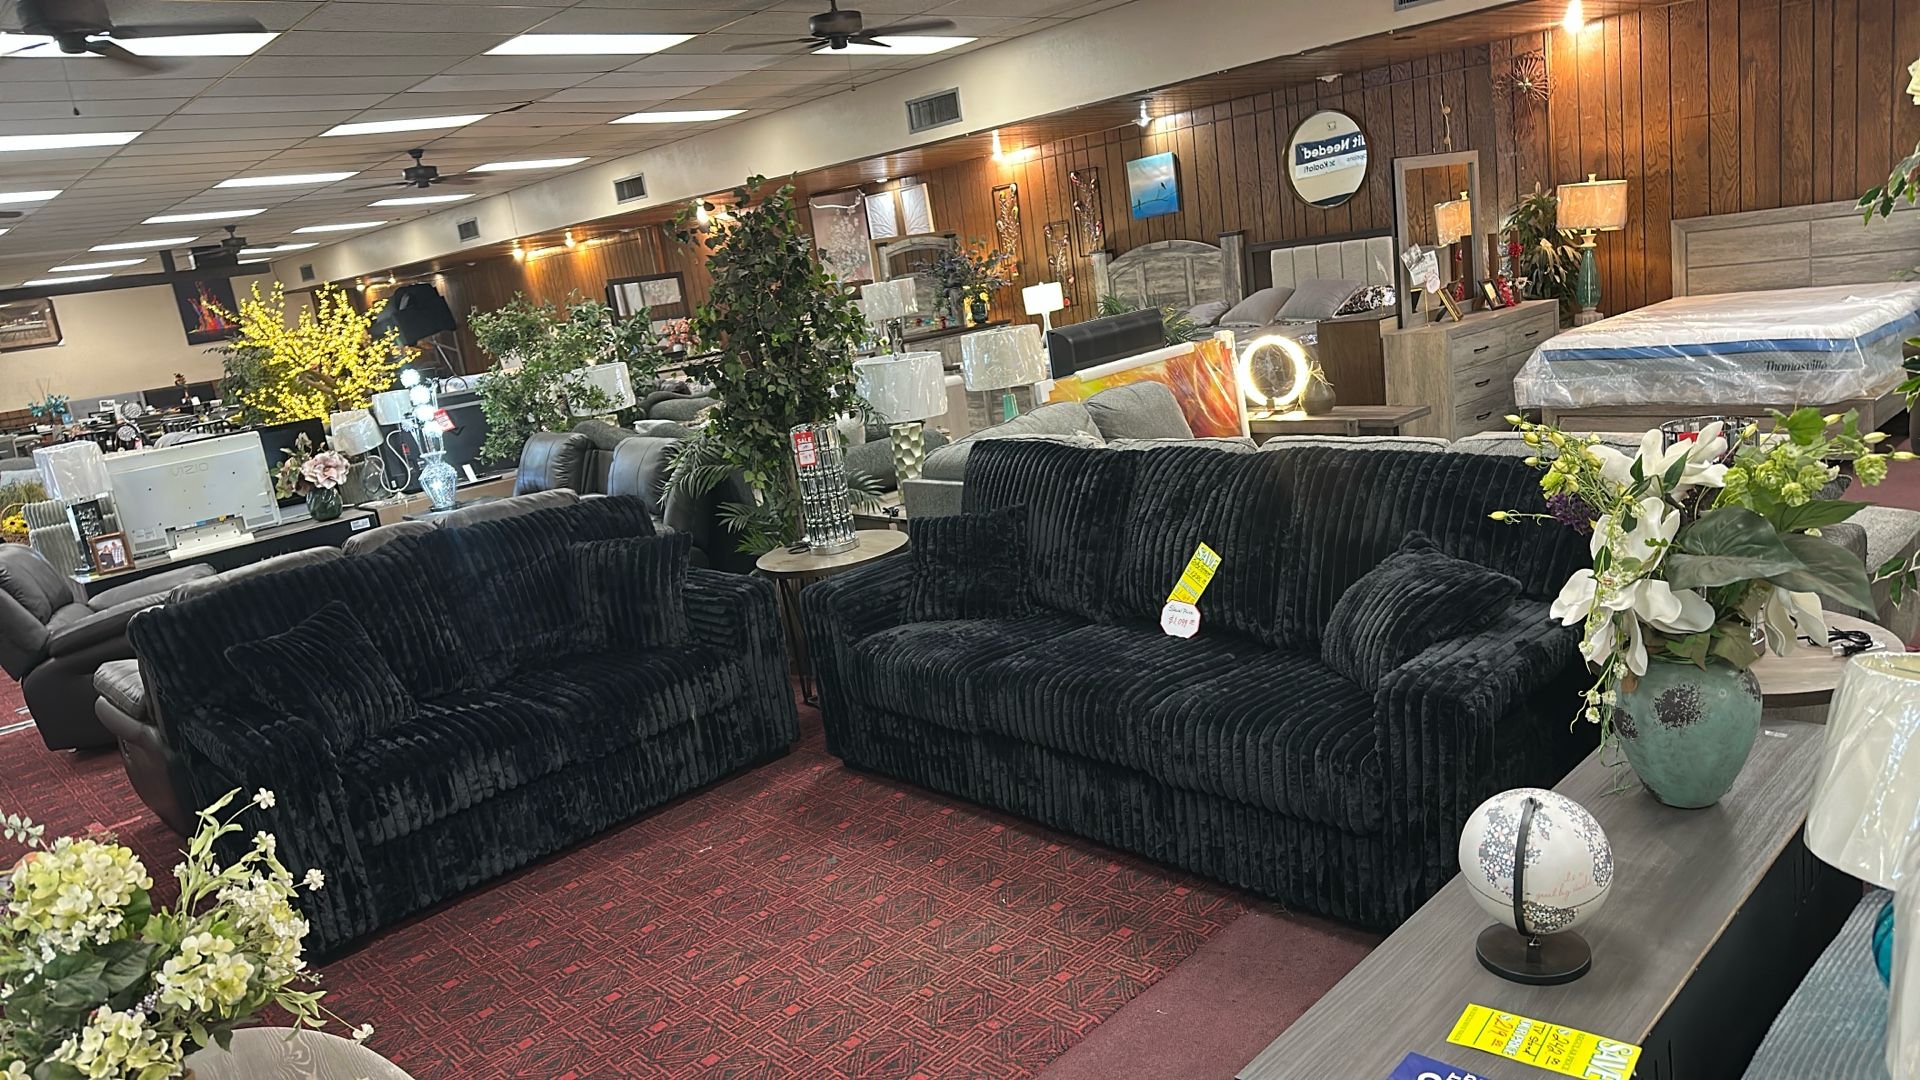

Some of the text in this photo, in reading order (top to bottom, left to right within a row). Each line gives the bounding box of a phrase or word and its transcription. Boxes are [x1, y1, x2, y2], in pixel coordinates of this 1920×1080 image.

[1764, 359, 1828, 372] Thomasville
[797, 436, 813, 444] SALE
[169, 462, 209, 479] VIZIO
[1197, 546, 1219, 570] SAVE
[1583, 1039, 1633, 1080] SAVE
